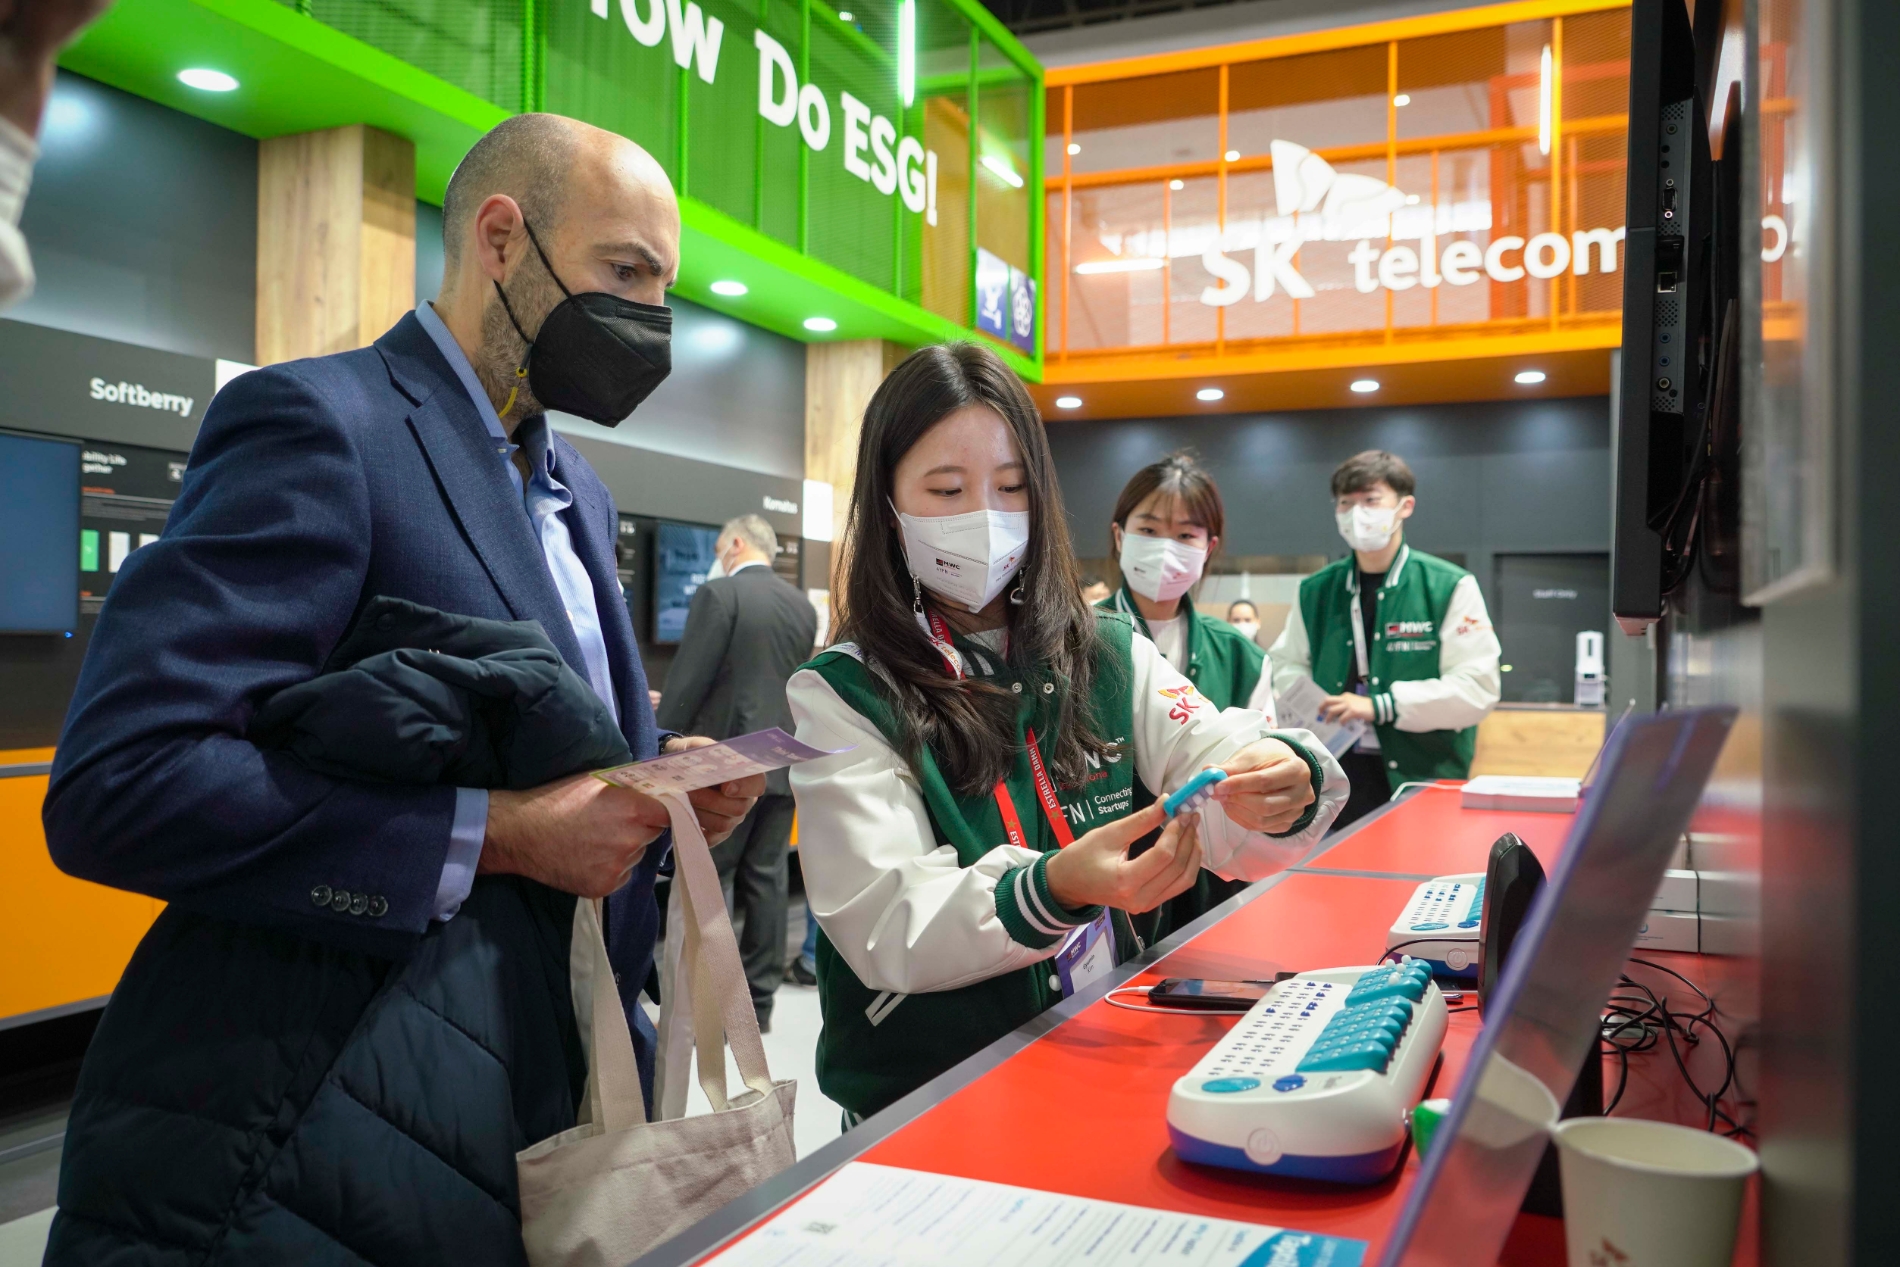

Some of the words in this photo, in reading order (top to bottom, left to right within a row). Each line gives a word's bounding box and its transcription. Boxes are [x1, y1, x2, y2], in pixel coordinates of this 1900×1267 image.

[755, 28, 831, 151] Do
[840, 90, 938, 227] ESG!
[1200, 232, 1316, 307] SK
[90, 377, 194, 417] Softberry
[1169, 697, 1200, 725] SK
[1029, 747, 1041, 771] DAMM
[1036, 770, 1057, 809] ESTRELLA
[1098, 800, 1129, 815] Startups
